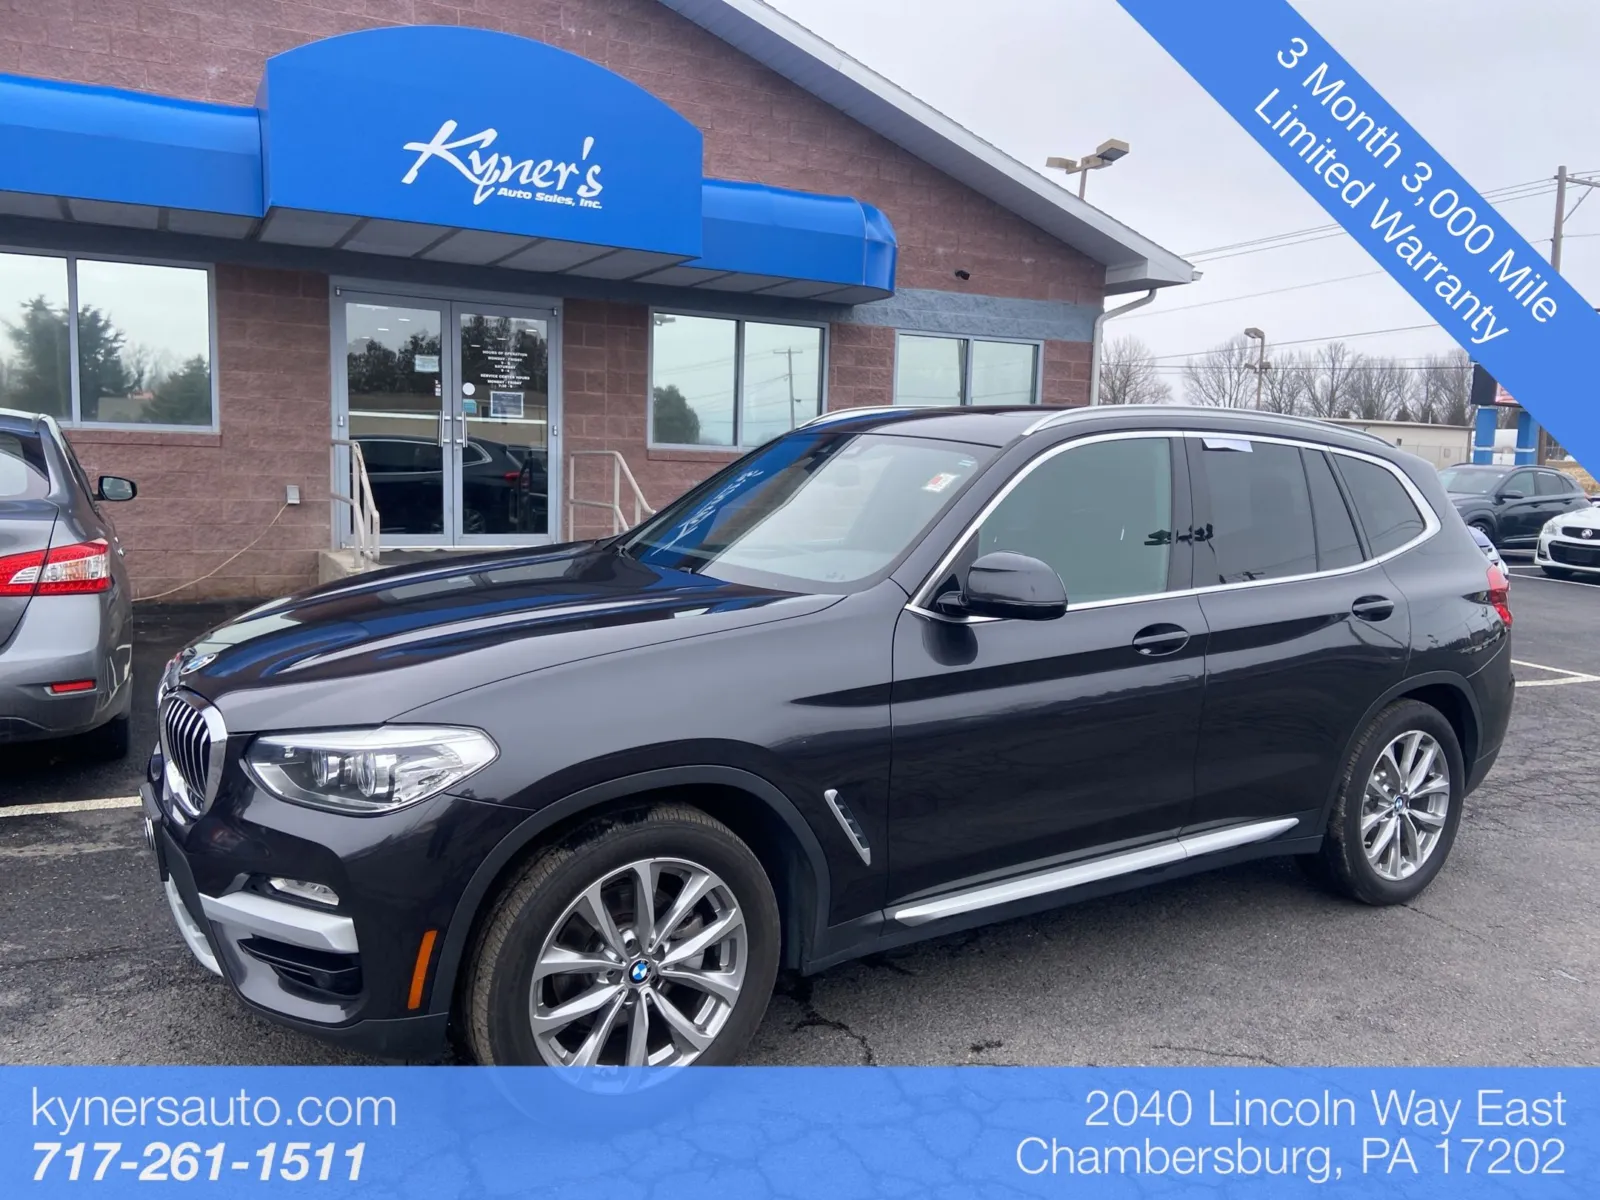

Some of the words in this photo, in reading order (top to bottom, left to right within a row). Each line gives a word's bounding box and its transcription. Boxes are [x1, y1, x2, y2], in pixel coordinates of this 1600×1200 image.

[401, 119, 604, 206] Kyner's
[497, 187, 532, 200] Auto
[535, 192, 576, 207] Sales,
[579, 198, 603, 209] Inc.
